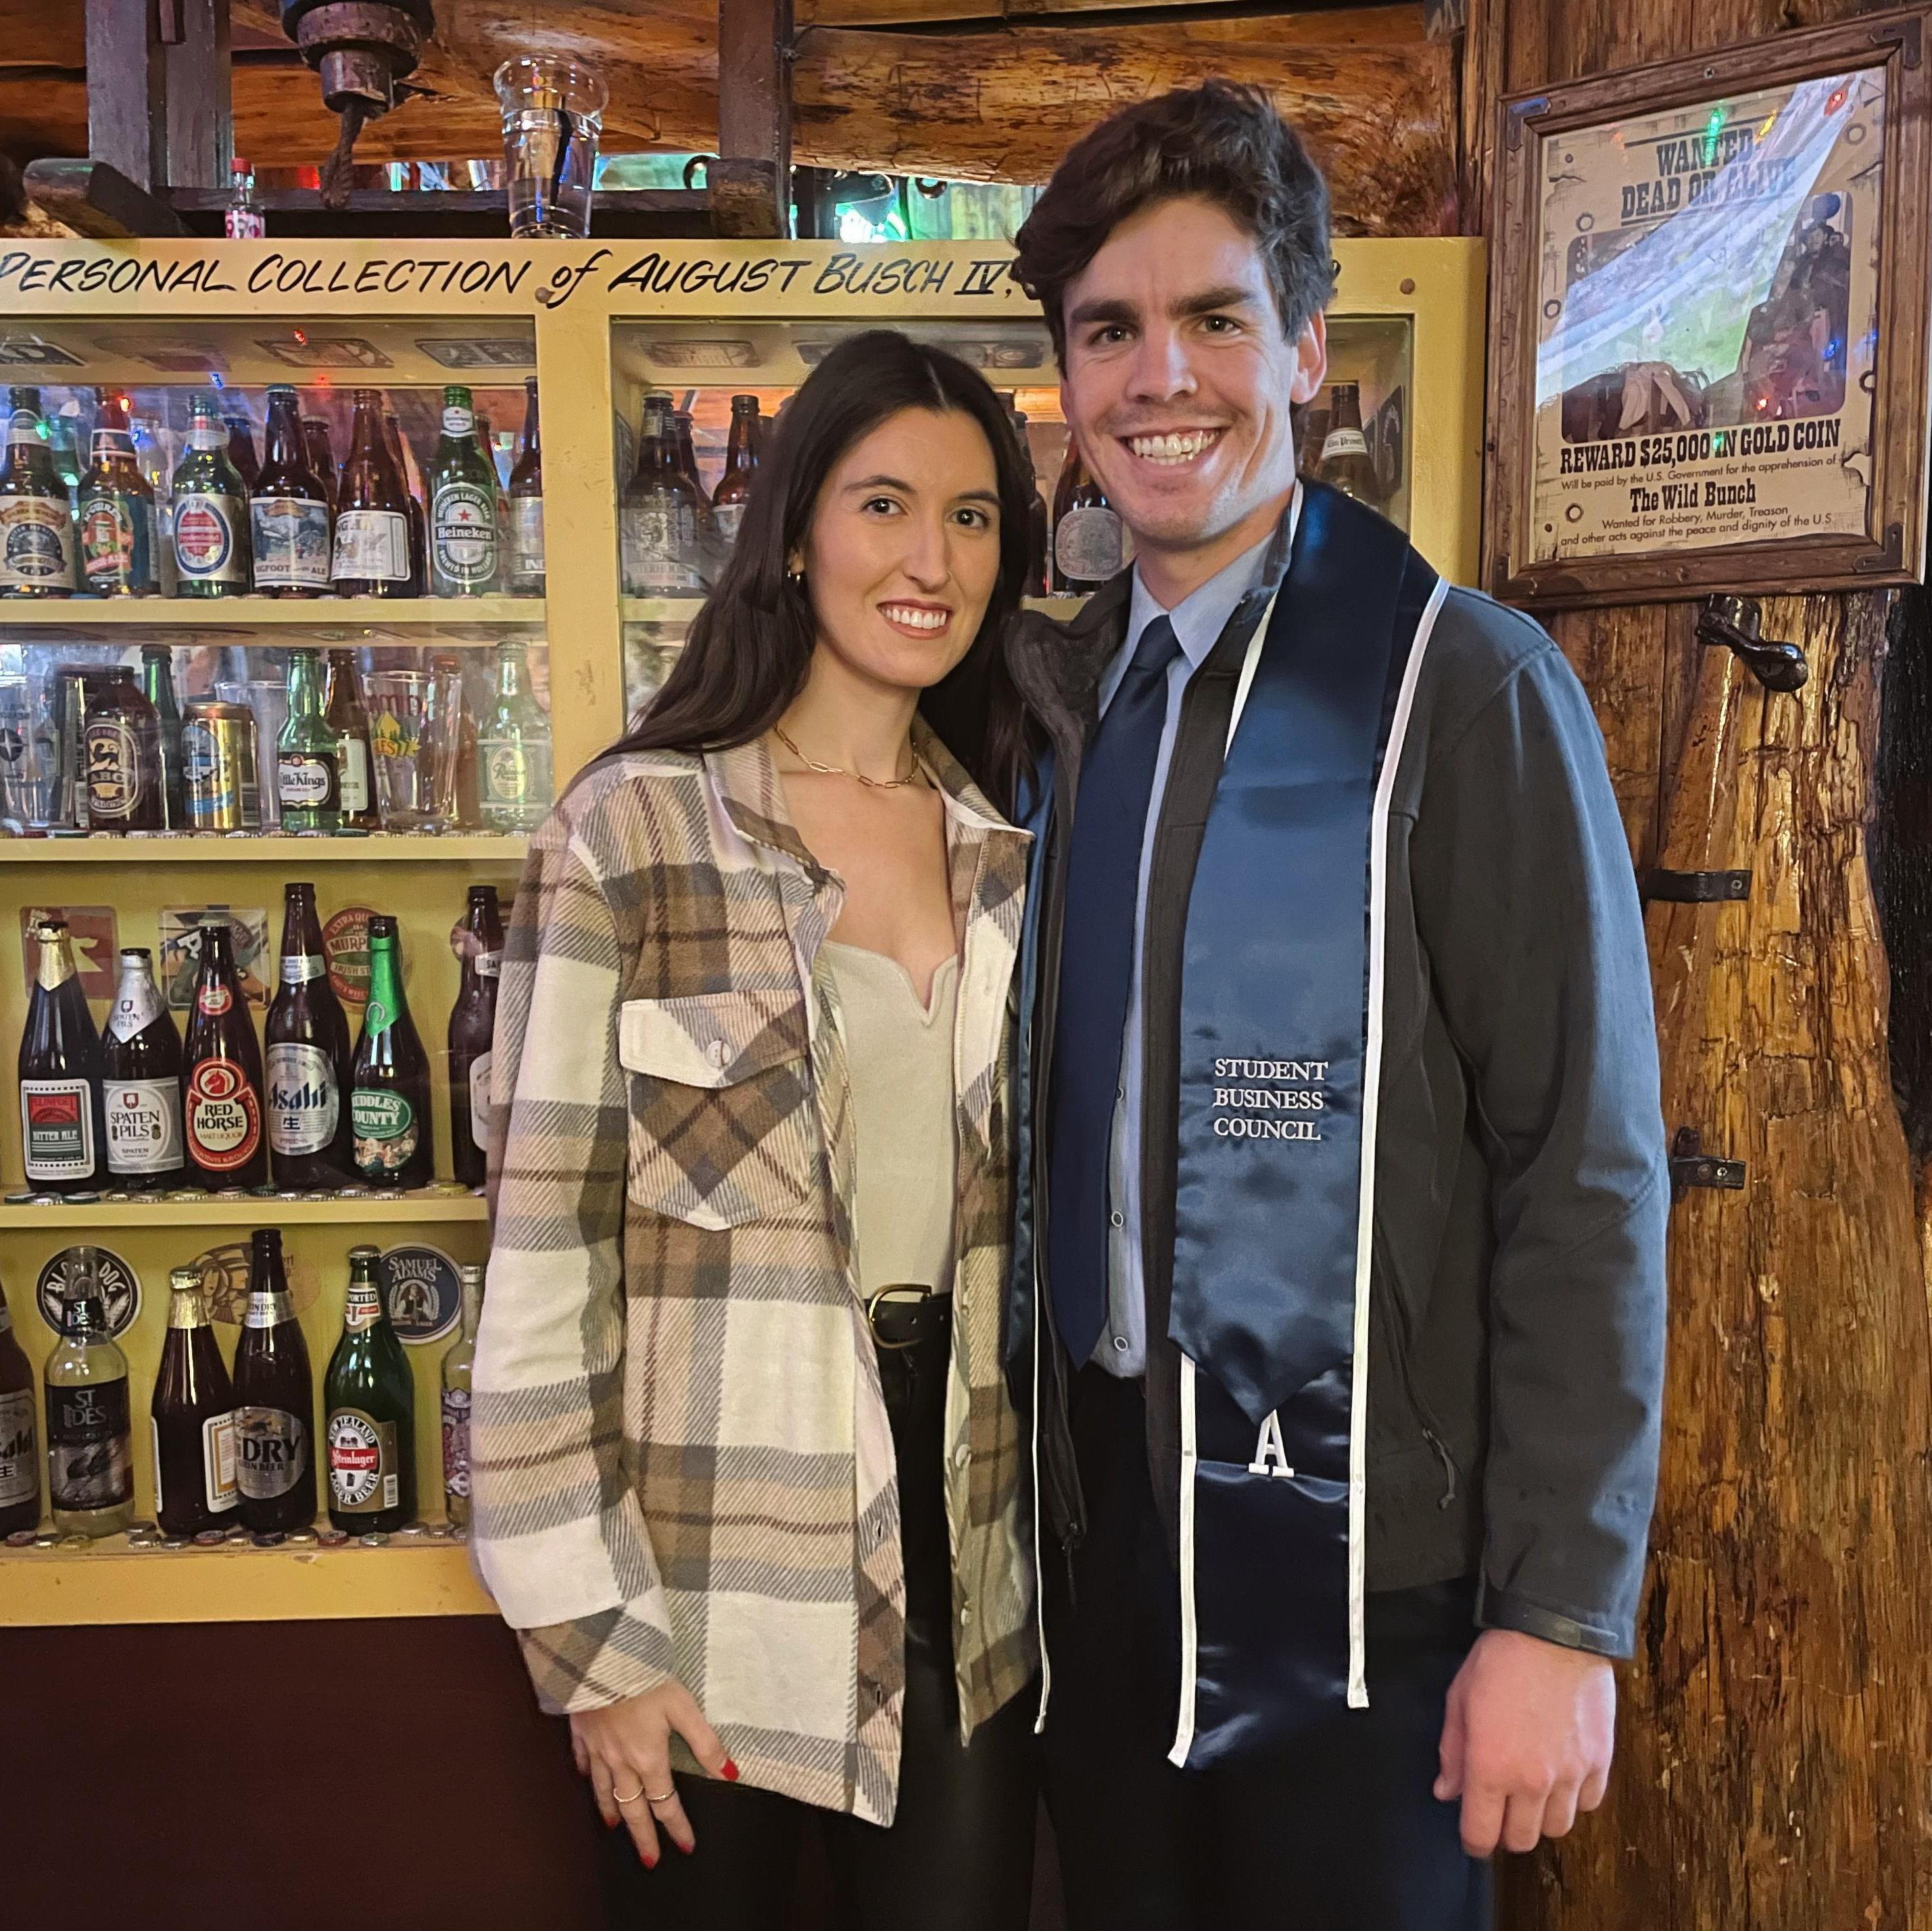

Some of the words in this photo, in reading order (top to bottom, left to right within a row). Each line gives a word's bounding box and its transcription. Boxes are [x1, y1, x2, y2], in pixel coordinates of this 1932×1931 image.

[1656, 128, 1753, 177] WANTED
[1621, 176, 1681, 218] DEAD
[1688, 170, 1717, 204] OR
[0, 252, 237, 292] PERSONAL
[247, 253, 532, 293] COLLECTION
[548, 249, 613, 309] of
[608, 252, 822, 294] AUGUST
[813, 252, 951, 295] BUSCH
[1560, 441, 1636, 474] REWARD
[1640, 433, 1711, 468] $25,000
[1714, 430, 1737, 458] IN
[1741, 424, 1790, 456] GOLD
[1793, 418, 1841, 451] COIN
[1562, 479, 1579, 490] Will
[1580, 479, 1593, 489] be
[1594, 477, 1614, 491] paid
[1616, 476, 1629, 489] by
[1630, 473, 1644, 483] the
[1646, 472, 1664, 483] U.S.
[1668, 467, 1724, 481] Government
[1726, 463, 1739, 474] for
[1741, 462, 1756, 472] the
[1758, 458, 1824, 474] apprehension
[1826, 454, 1837, 466] of
[1630, 487, 1660, 514] The
[1662, 482, 1699, 510] Wild
[1704, 478, 1756, 508] Bunch
[1561, 533, 1579, 546] and
[1582, 532, 1607, 543] other
[1608, 531, 1627, 542] acts
[1630, 529, 1666, 542] against
[1668, 526, 1683, 537] the
[1686, 525, 1716, 539] peace
[1719, 521, 1739, 533] and
[1742, 519, 1777, 533] dignity
[1780, 514, 1792, 527] of
[1793, 514, 1810, 526] the
[1601, 516, 1640, 530] Wanted
[1643, 514, 1656, 527] for
[1659, 513, 1704, 526] Robbery,
[1706, 510, 1745, 522] Murder,
[1749, 507, 1788, 518] Treason
[437, 526, 492, 540] Heineken
[311, 566, 327, 575] ALE
[330, 914, 354, 935] EXTRA
[335, 965, 358, 975] IRISH
[113, 1013, 140, 1021] SPATEN
[117, 1020, 134, 1028] PILS
[1214, 1058, 1328, 1081] STUDENT
[270, 1081, 327, 1110] Asahi
[1211, 1087, 1324, 1110] BUSINESS
[110, 1109, 160, 1125] SPATEN
[205, 1104, 233, 1117] RED
[61, 1129, 78, 1140] ALE
[120, 1124, 150, 1138] PILS
[197, 1116, 244, 1131] HORSE
[283, 1116, 301, 1131] 生
[1213, 1117, 1322, 1141] COUNCIL
[388, 1256, 442, 1271] SAMUEL
[391, 1266, 437, 1283] ADAMS
[98, 1261, 126, 1293] DOG
[62, 1404, 107, 1429] IDES
[340, 1416, 376, 1444] ZEALAND
[243, 1436, 301, 1463] DRY
[1248, 1409, 1295, 1478] A
[259, 1462, 284, 1471] BEER
[355, 1472, 379, 1501] BEER
